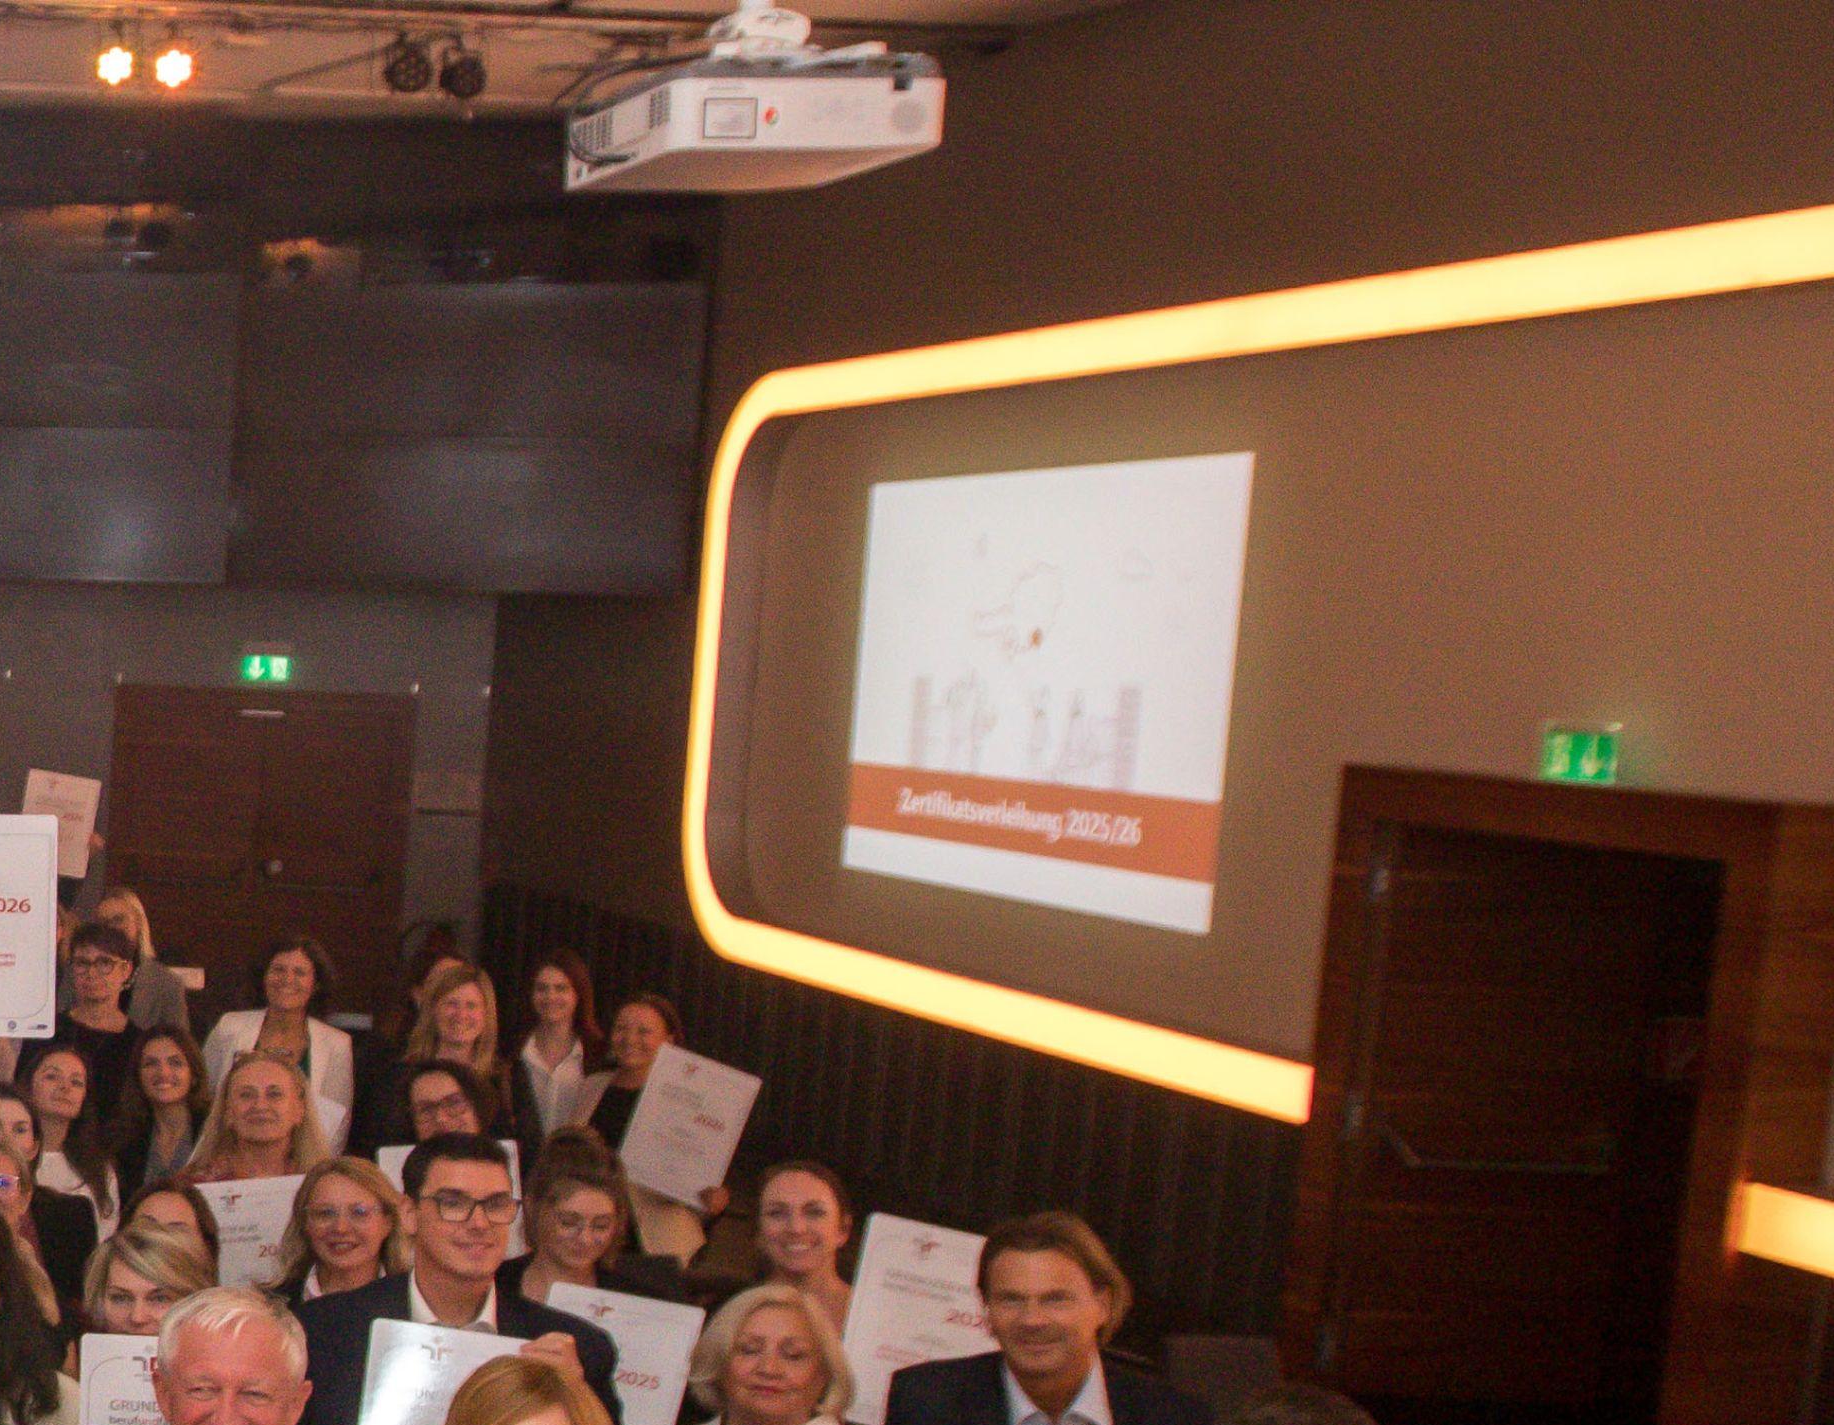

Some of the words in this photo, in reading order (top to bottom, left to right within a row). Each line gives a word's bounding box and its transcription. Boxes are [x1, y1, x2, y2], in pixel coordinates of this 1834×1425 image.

[897, 787, 1065, 843] Zertifikatsverleihung
[1066, 808, 1143, 848] 2025/26
[258, 1245, 278, 1258] 20
[946, 1308, 984, 1328] 202
